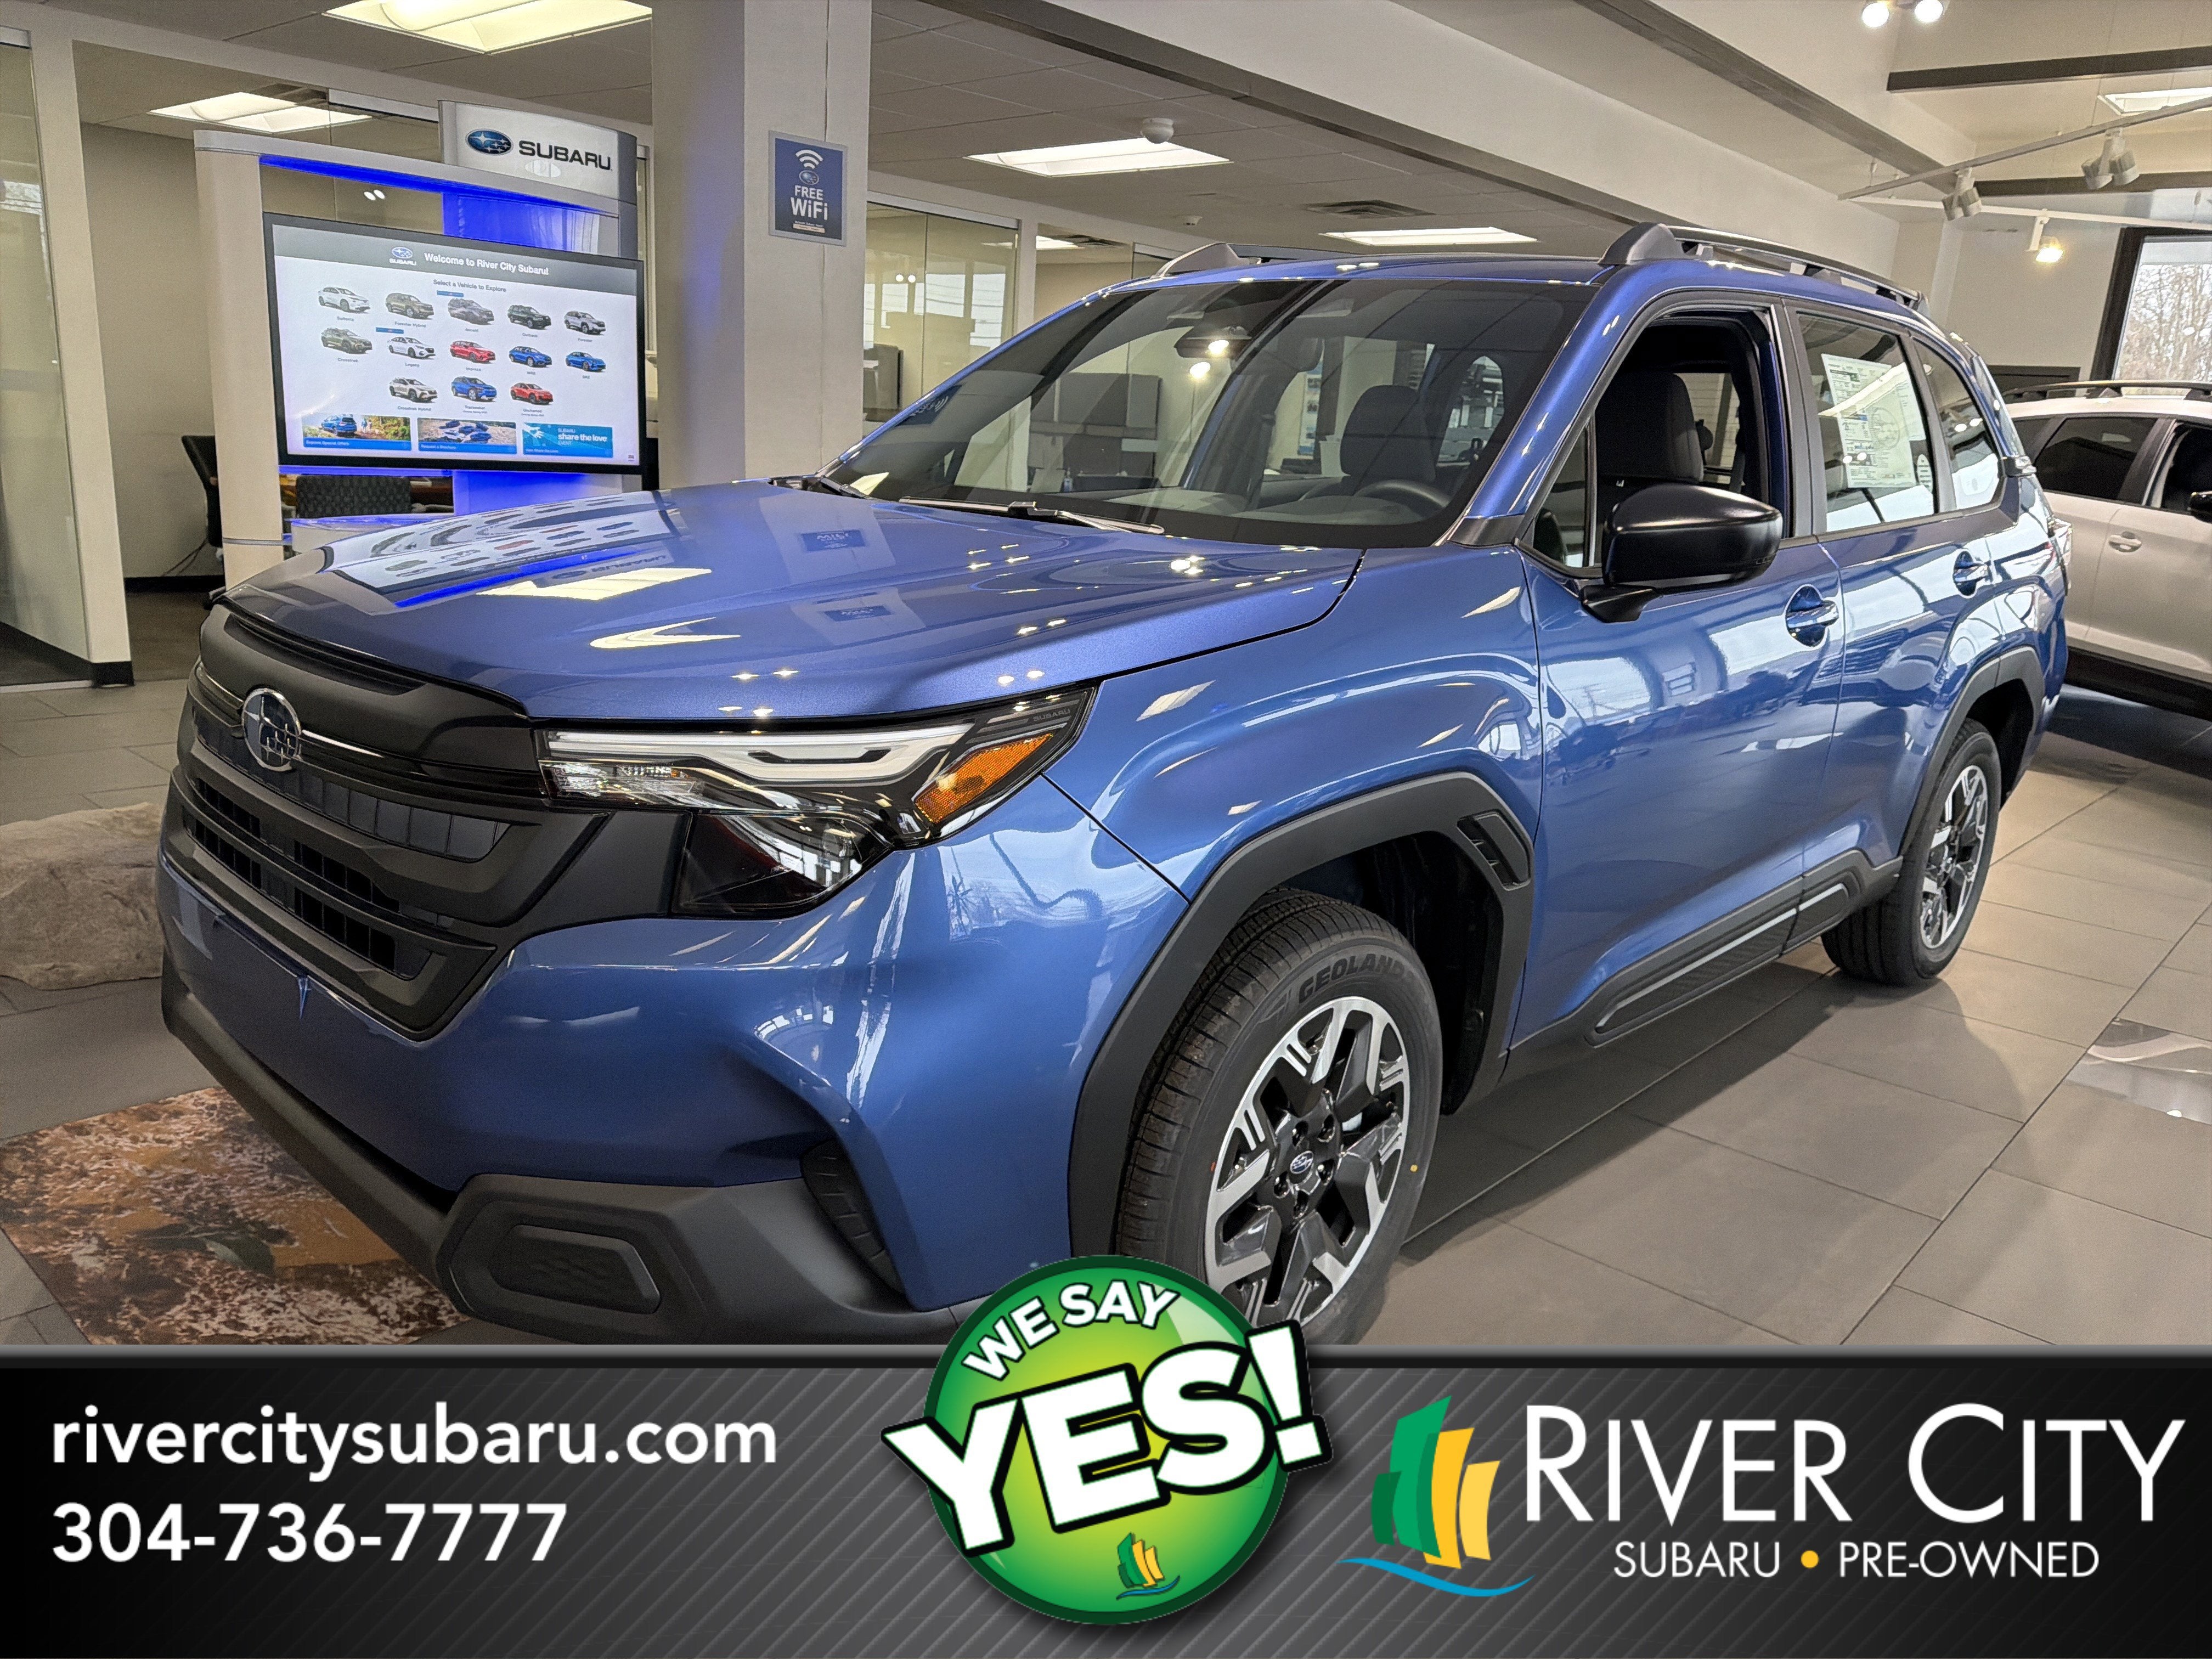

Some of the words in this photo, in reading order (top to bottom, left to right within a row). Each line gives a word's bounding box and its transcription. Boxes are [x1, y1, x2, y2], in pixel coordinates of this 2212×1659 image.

[519, 140, 611, 171] SUBARU
[795, 185, 823, 200] FREE
[791, 197, 828, 220] WiFi
[424, 253, 464, 265] Welcome
[466, 258, 475, 267] to
[477, 259, 498, 269] River
[500, 262, 516, 273] City
[518, 264, 549, 275] Subaru!
[592, 434, 607, 442] love
[1033, 707, 1070, 721] SUBARU
